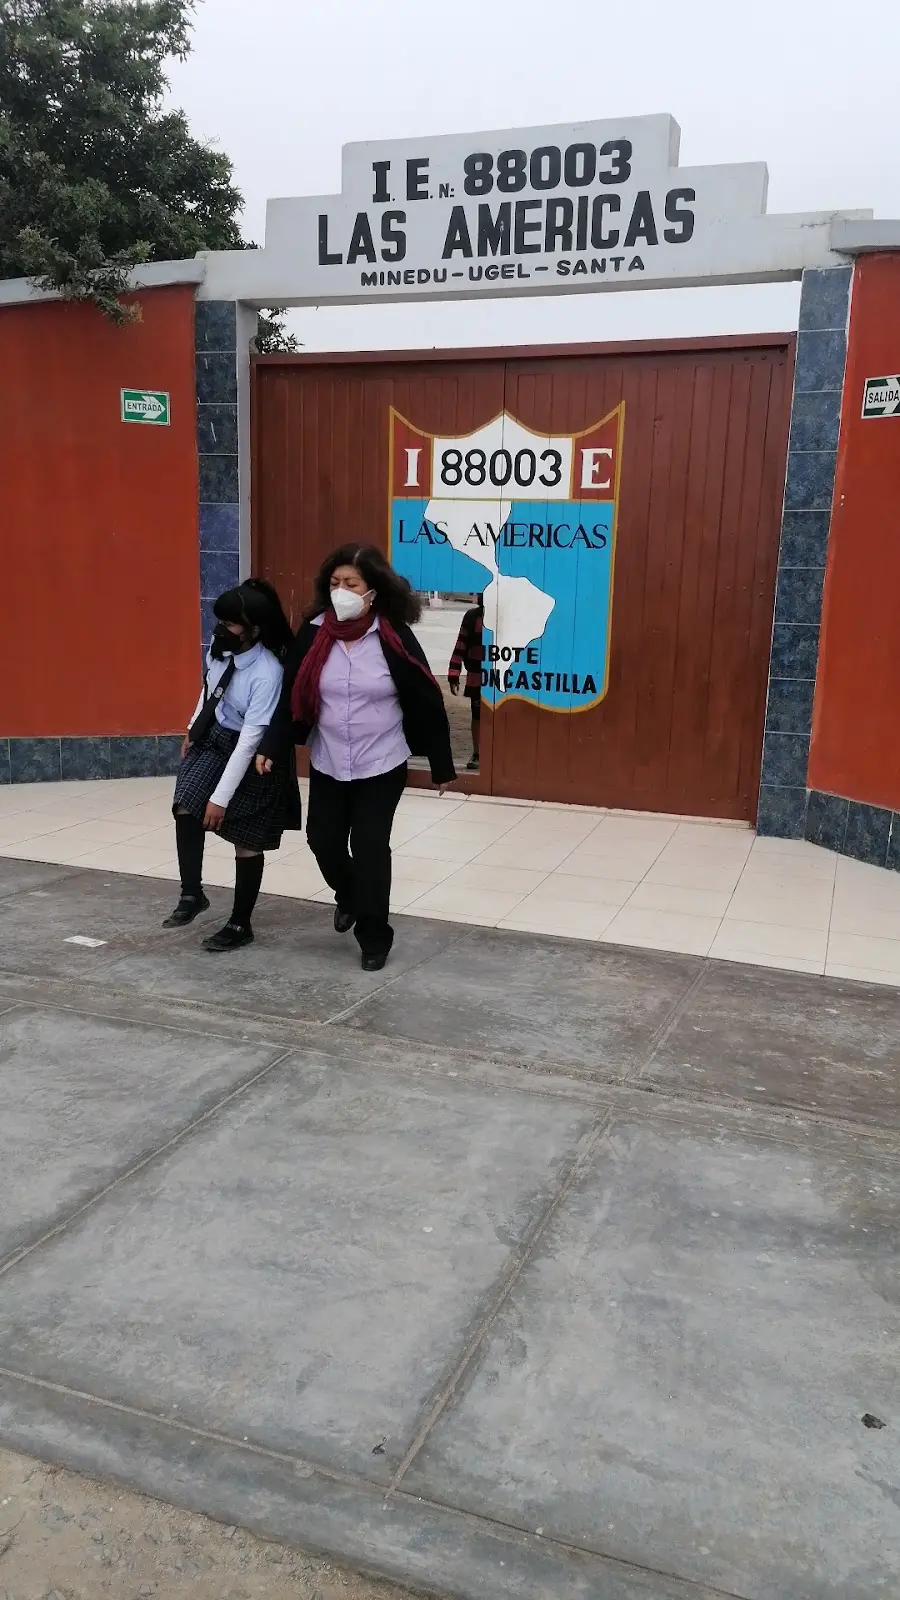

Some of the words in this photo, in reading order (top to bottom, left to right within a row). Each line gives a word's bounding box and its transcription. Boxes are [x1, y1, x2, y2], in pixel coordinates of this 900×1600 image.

[463, 139, 633, 197] 88003
[318, 209, 407, 266] LAS
[441, 187, 696, 260] AMERICAS
[127, 401, 163, 412] ENTRADA
[868, 389, 900, 404] SALIDA
[404, 448, 422, 487] I
[440, 448, 562, 487] 88003
[580, 448, 613, 489] E
[398, 519, 448, 545] LAS
[463, 522, 609, 549] AMERICAS
